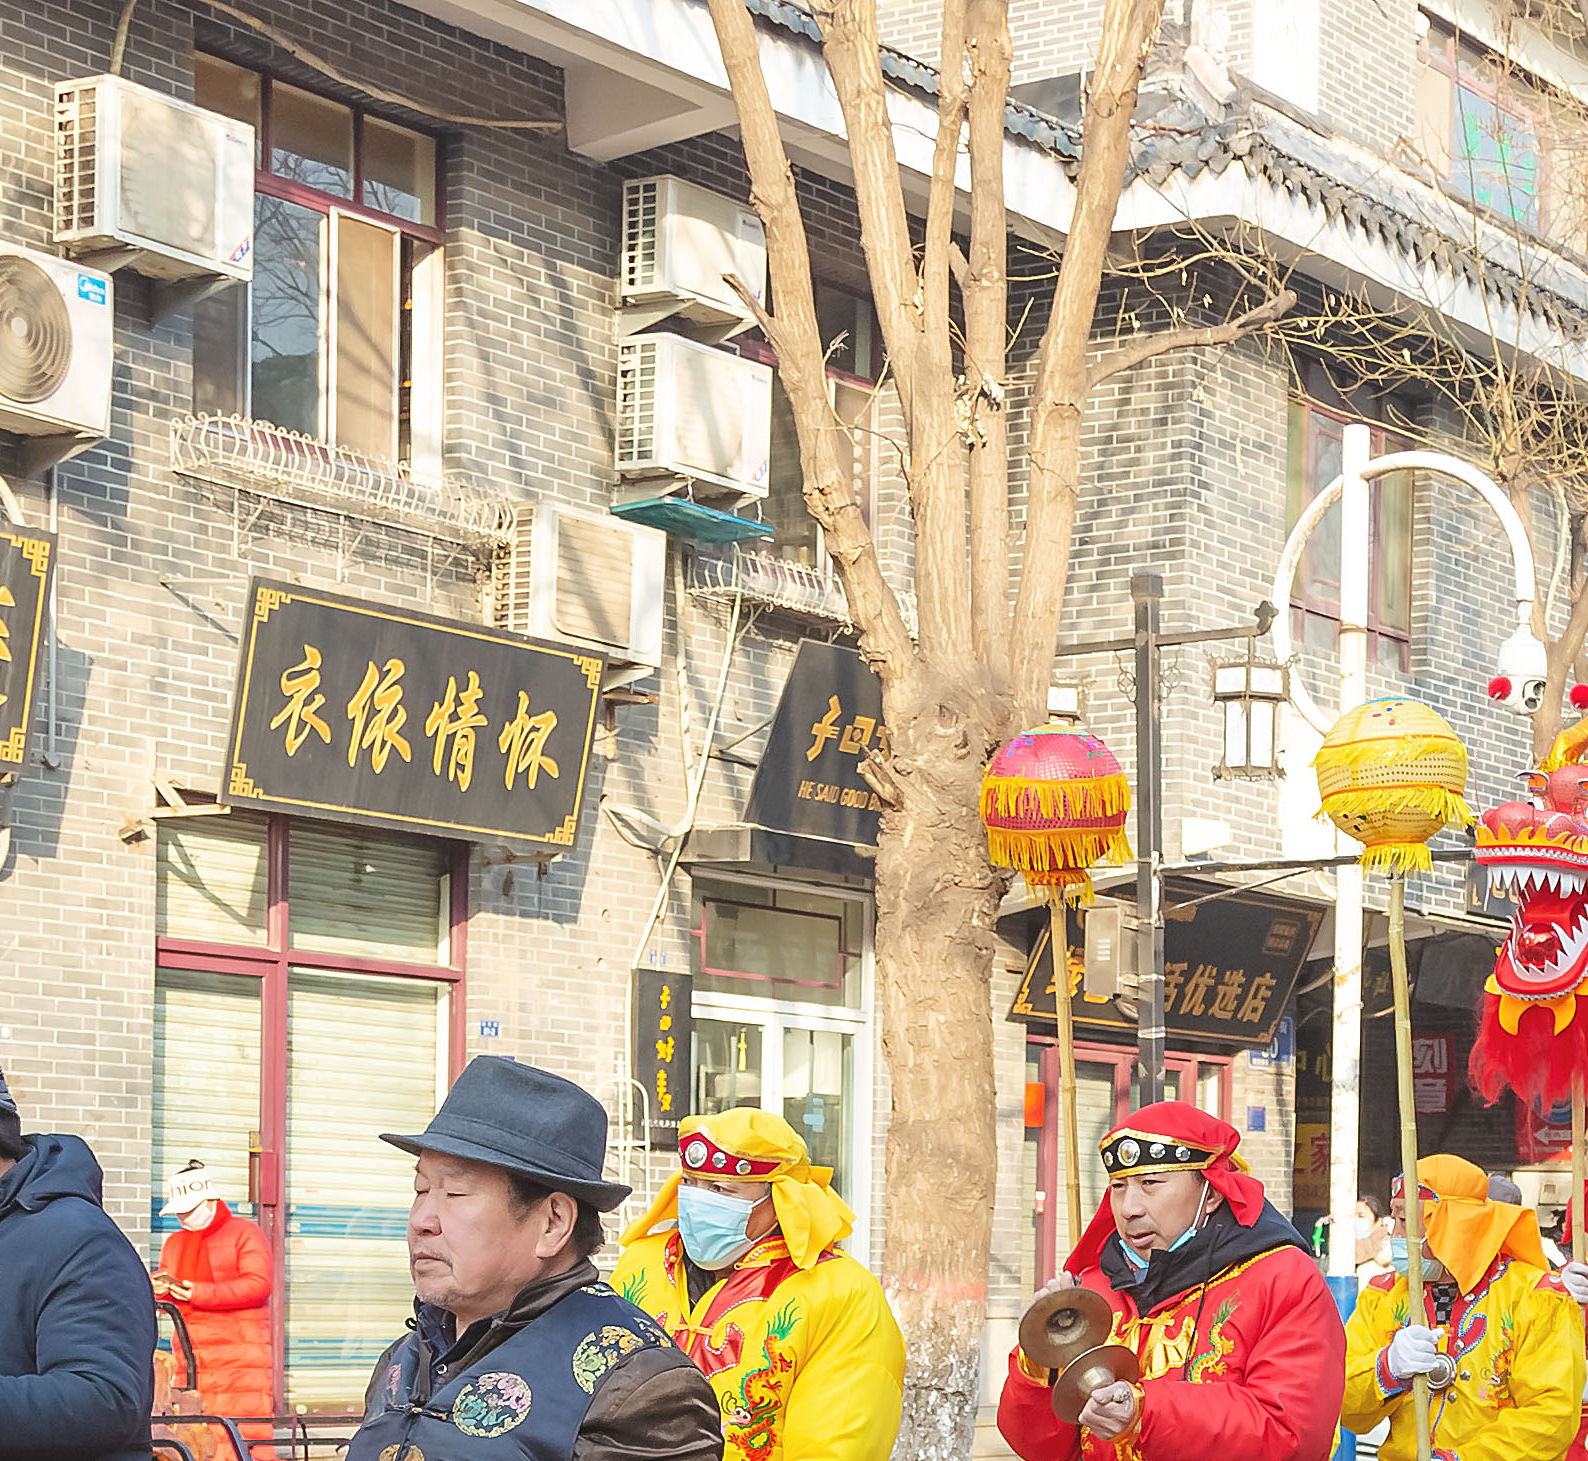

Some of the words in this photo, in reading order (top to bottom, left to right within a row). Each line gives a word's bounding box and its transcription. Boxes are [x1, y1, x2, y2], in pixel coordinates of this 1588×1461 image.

[269, 645, 560, 793] 衣依情怀
[797, 781, 814, 799] HE
[815, 783, 840, 805] SAID
[840, 787, 868, 810] GOOD
